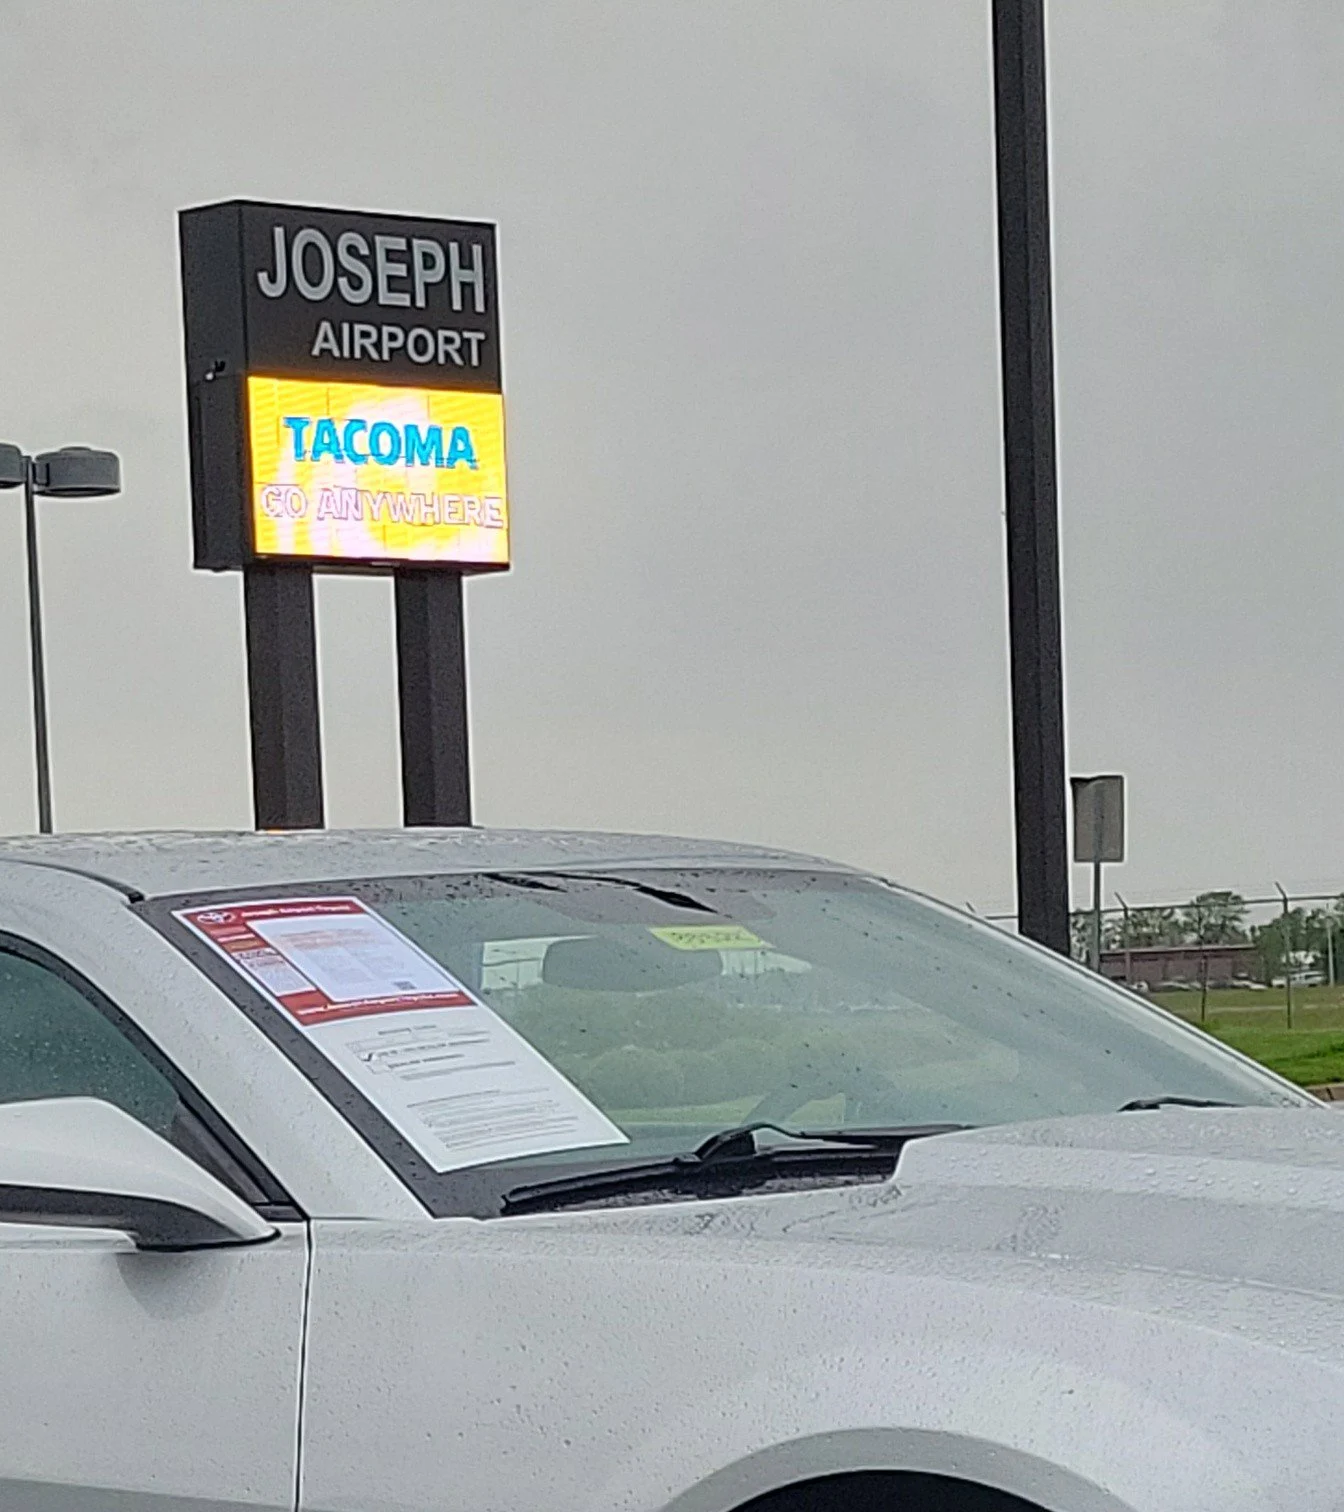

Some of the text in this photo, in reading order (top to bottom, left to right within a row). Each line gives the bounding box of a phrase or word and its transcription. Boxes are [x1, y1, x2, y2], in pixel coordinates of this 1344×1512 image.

[257, 226, 485, 313] JOSEPH
[311, 321, 485, 367] AIRPORT
[283, 416, 479, 470] TACOMA
[261, 485, 504, 529] GO ANYWHERE
